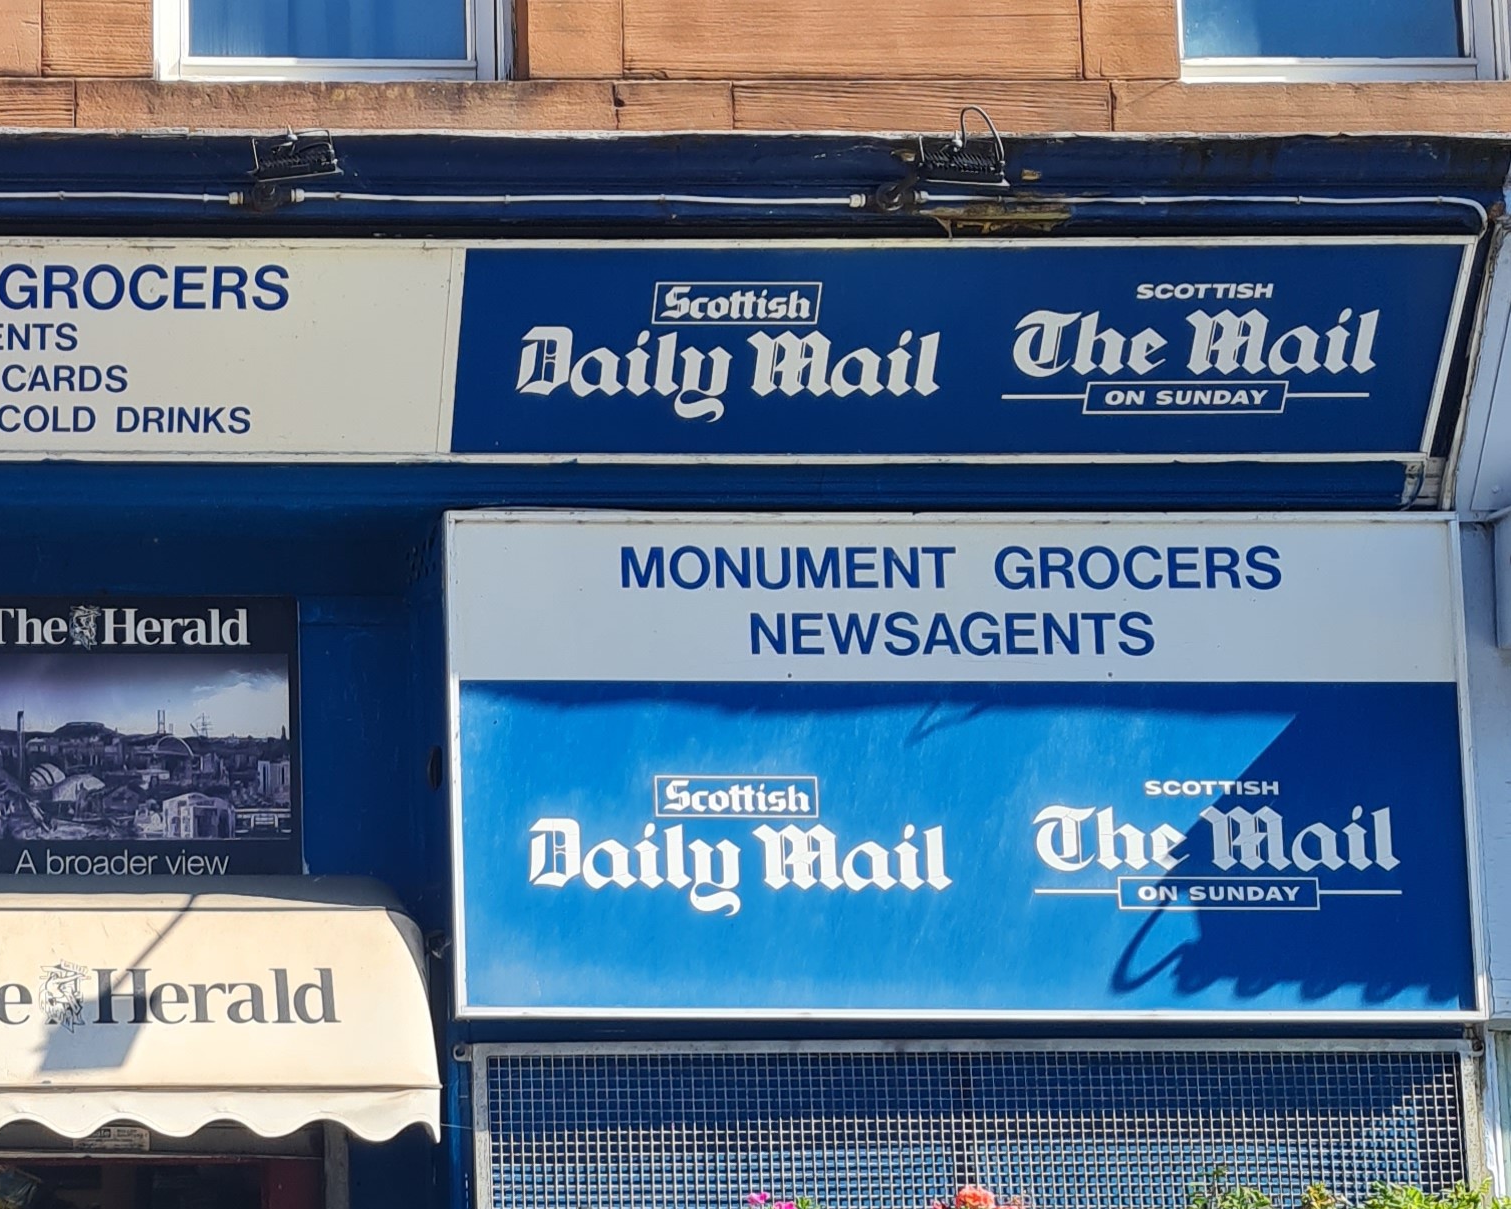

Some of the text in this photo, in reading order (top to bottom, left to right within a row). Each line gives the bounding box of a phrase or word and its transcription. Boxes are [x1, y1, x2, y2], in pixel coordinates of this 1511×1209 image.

[662, 286, 812, 322] Scottish
[1136, 283, 1275, 301] SCOTTISH
[1012, 308, 1377, 378] The Mail
[0, 363, 129, 394] CARDS
[515, 325, 941, 423] Daily Mail
[1104, 389, 1269, 407] ON SUNDAY
[116, 406, 251, 436] DRINKS
[621, 544, 1283, 592] MONUMENT GROCERS
[101, 607, 251, 647] Herald
[750, 611, 1156, 657] NEWSAGENTS
[664, 780, 810, 814] Scottish
[1145, 780, 1280, 797] SCOTTISH
[1033, 806, 1401, 873] The Mail
[15, 849, 230, 876] A broader view
[529, 818, 952, 917] Daily Mail
[1137, 885, 1301, 902] ON SUNDAY
[90, 968, 342, 1025] Herald
